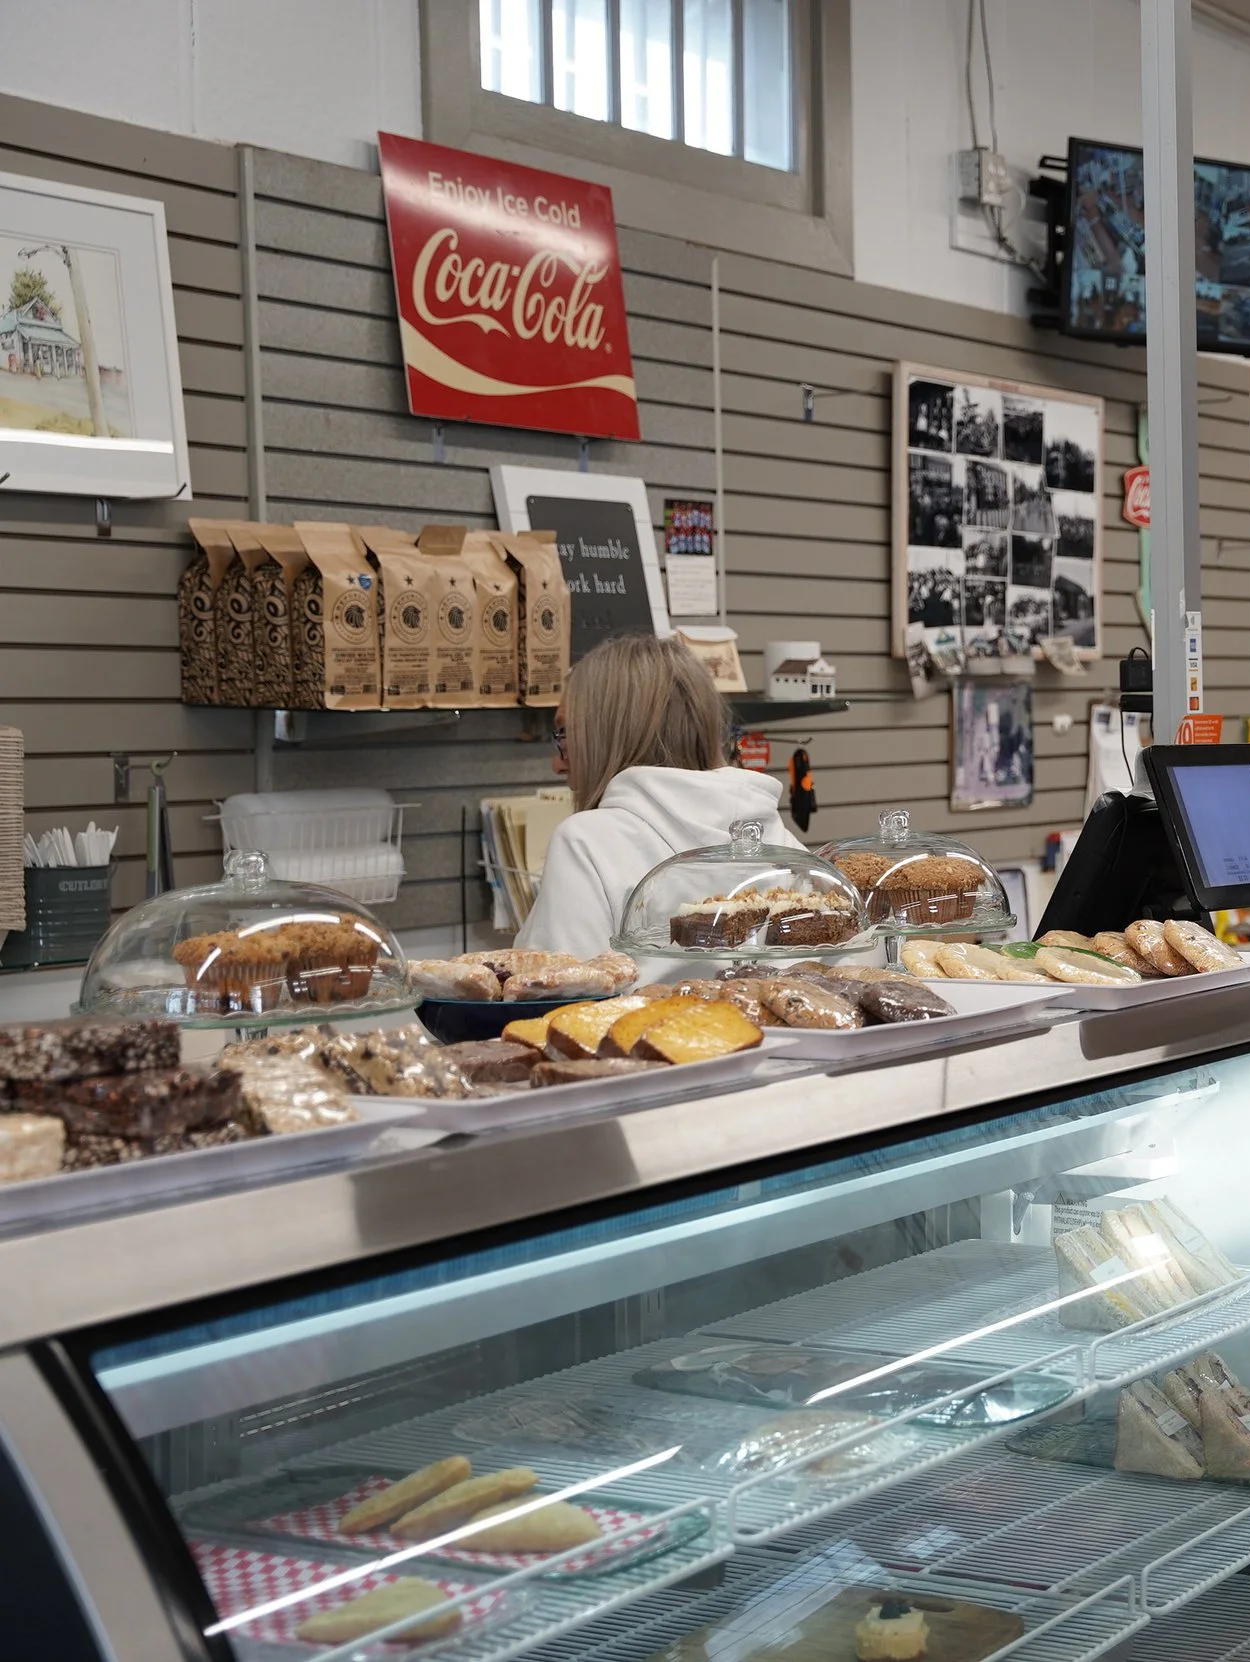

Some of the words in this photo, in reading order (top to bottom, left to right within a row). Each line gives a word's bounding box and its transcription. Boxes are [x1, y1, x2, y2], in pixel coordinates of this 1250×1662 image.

[428, 171, 490, 208] Enjoy
[497, 187, 529, 217] Ice
[534, 195, 581, 228] Cold
[412, 228, 609, 351] Coca-Cola
[558, 543, 575, 561] ay
[578, 536, 630, 560] humble
[566, 572, 591, 593] ork
[593, 573, 627, 595] hard
